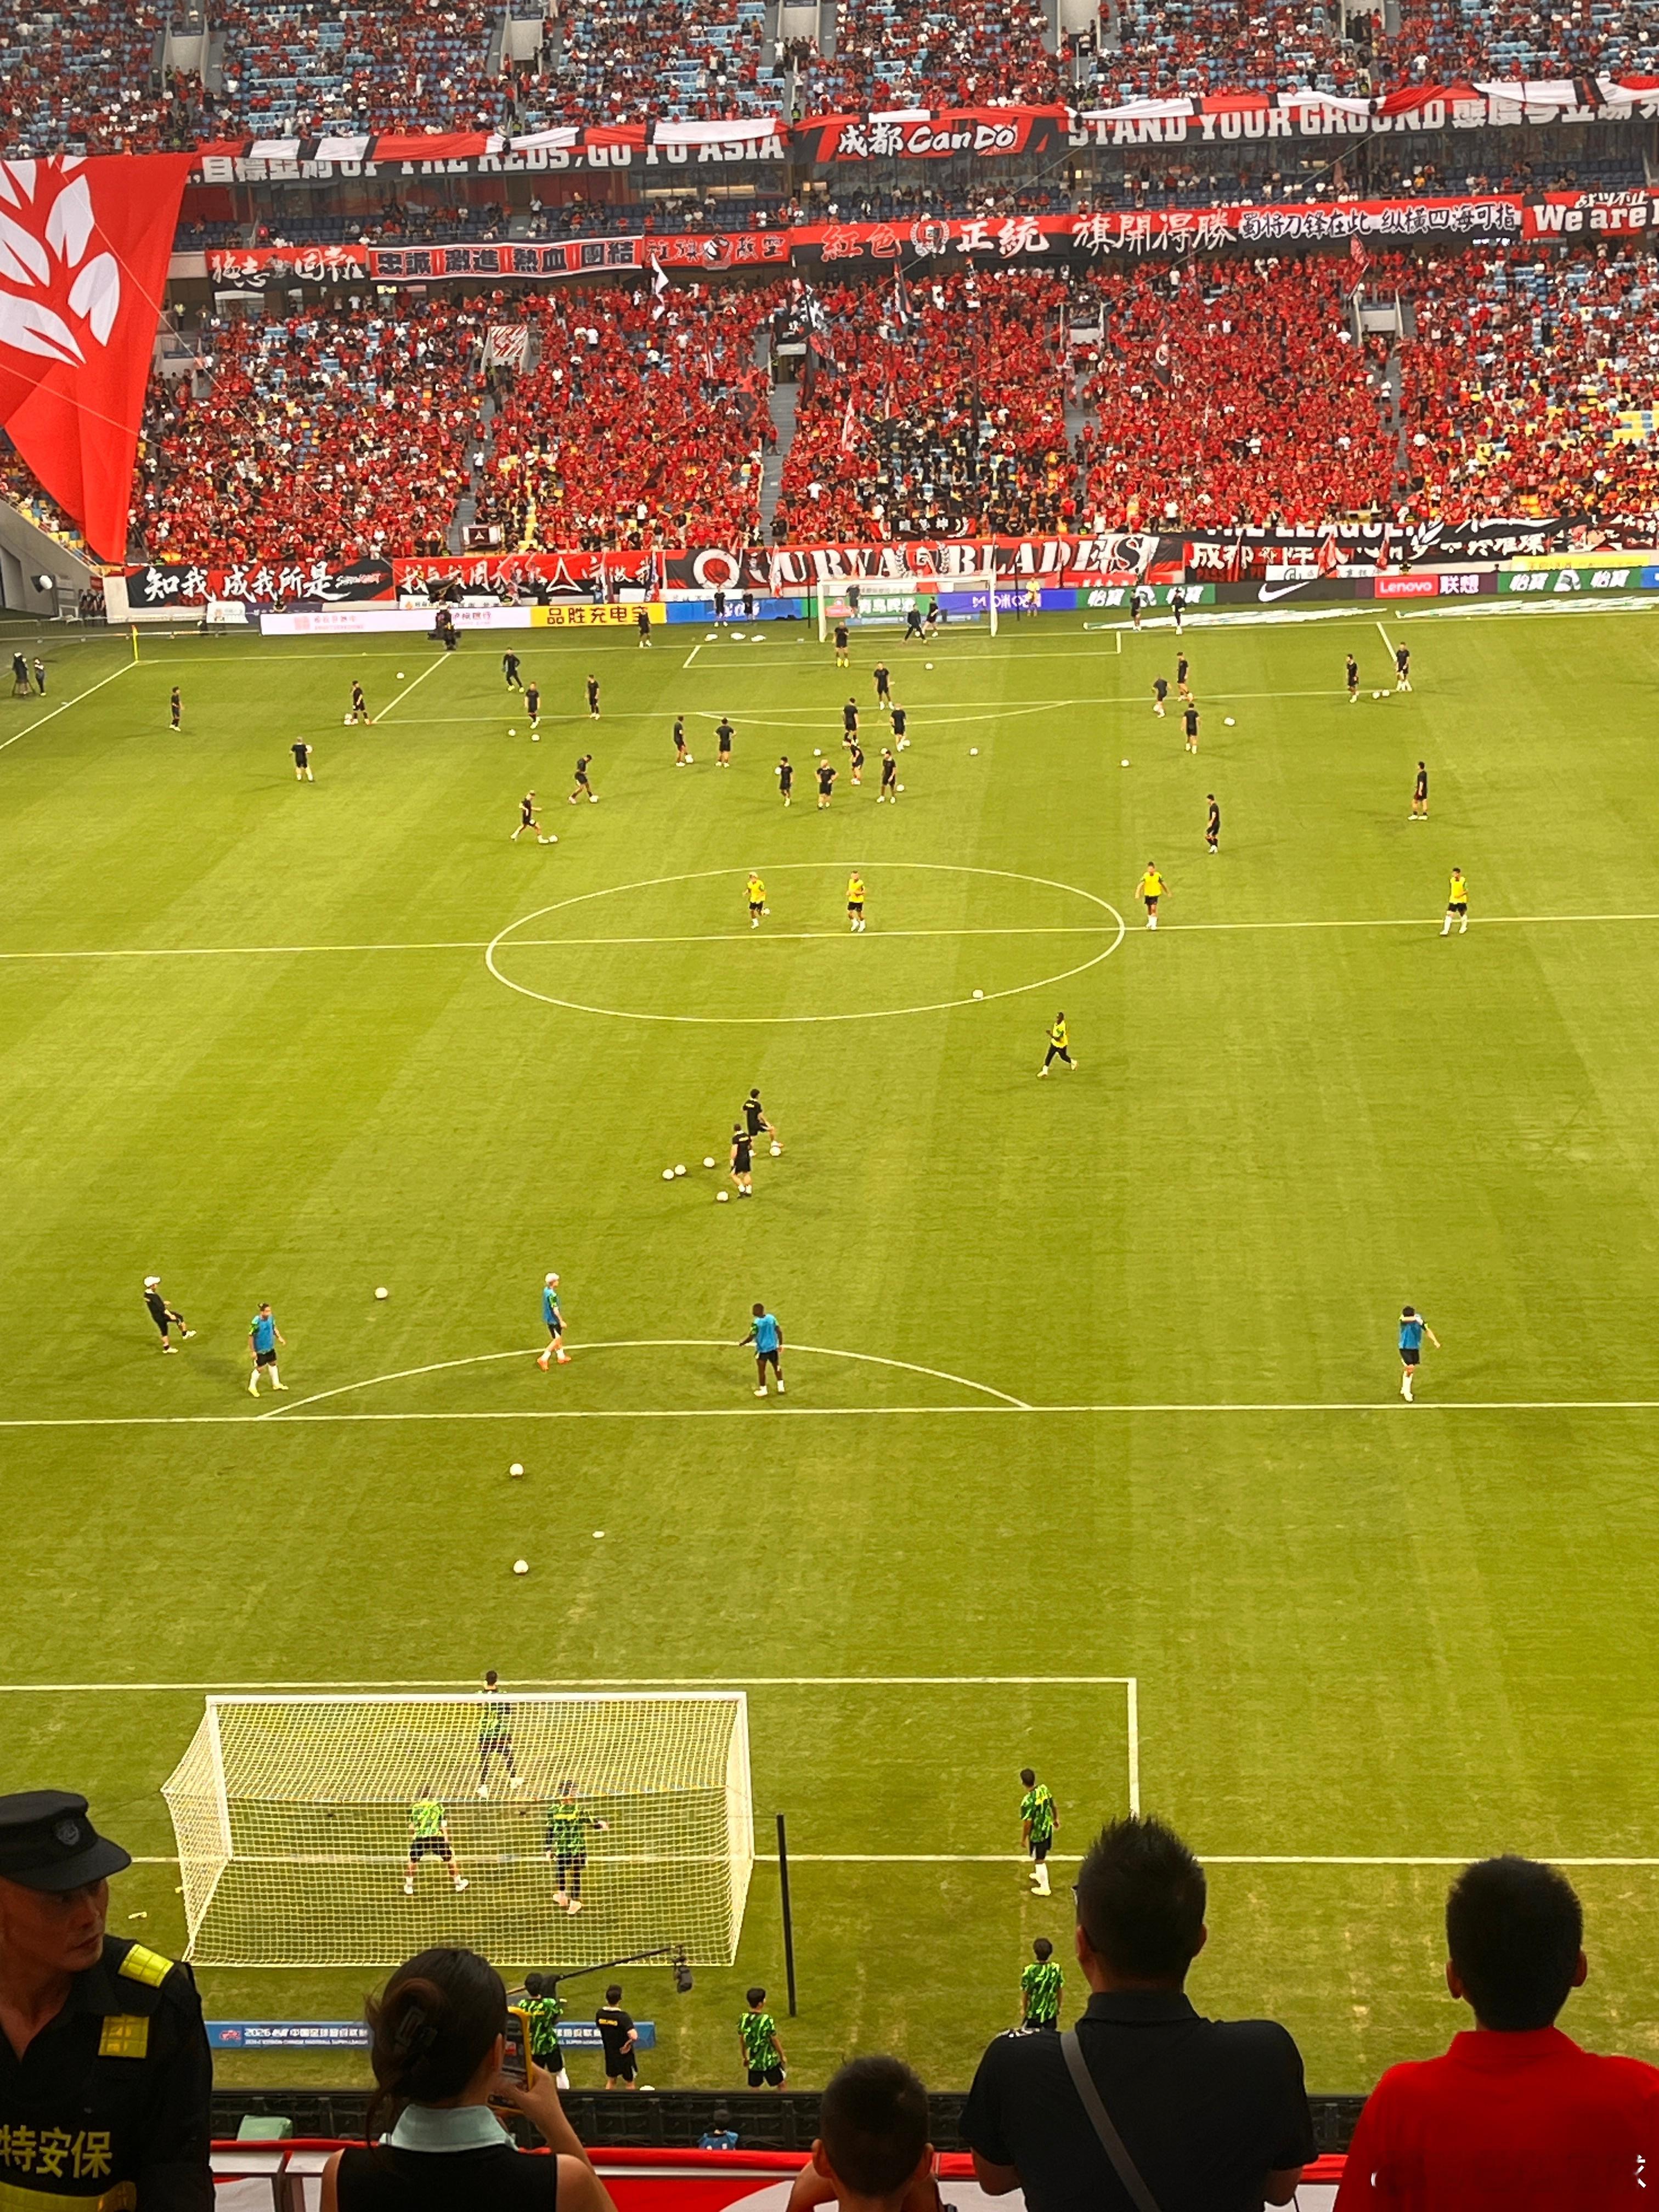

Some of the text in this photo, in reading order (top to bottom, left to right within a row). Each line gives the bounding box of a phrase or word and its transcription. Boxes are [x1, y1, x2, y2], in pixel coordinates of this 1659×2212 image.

[1199, 108, 1293, 140] YOUR
[1300, 99, 1446, 136] GROUND
[698, 134, 785, 162] ASIA
[838, 123, 904, 157] 成都
[1071, 208, 1238, 257] 旗開得勝
[1533, 204, 1583, 232] We
[1590, 206, 1647, 229] are
[956, 216, 1051, 259] 正統
[511, 246, 568, 273] 熱血
[944, 535, 1147, 577] BLADES
[144, 561, 352, 602] 知我 成我所是
[1380, 580, 1433, 594] Lenovo
[1440, 574, 1480, 595] 联想
[0, 2124, 113, 2179] 特安保
